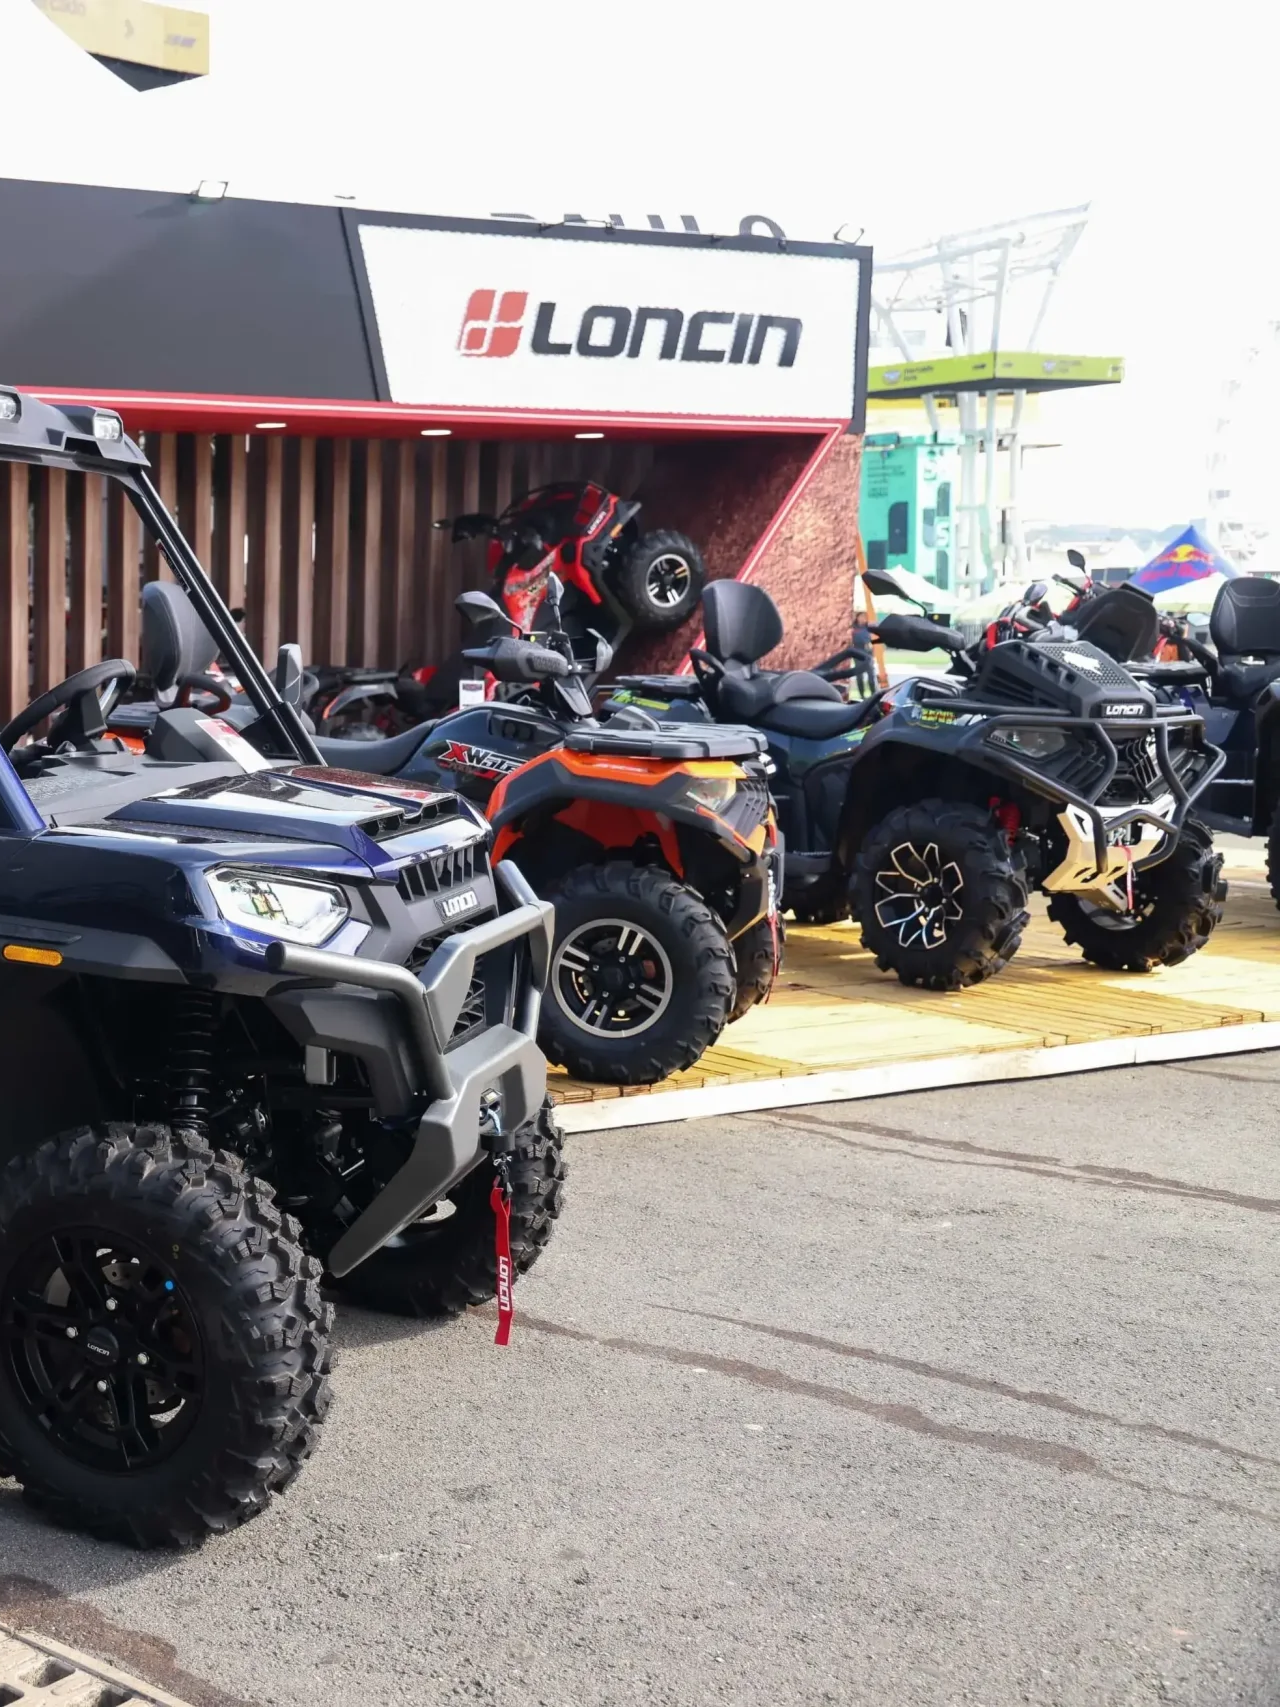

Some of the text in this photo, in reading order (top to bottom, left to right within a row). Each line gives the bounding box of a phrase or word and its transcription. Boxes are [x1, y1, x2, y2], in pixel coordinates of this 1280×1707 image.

[531, 302, 803, 367] LONCIN
[1106, 705, 1144, 715] LONCIN
[499, 1256, 510, 1311] LONCIN
